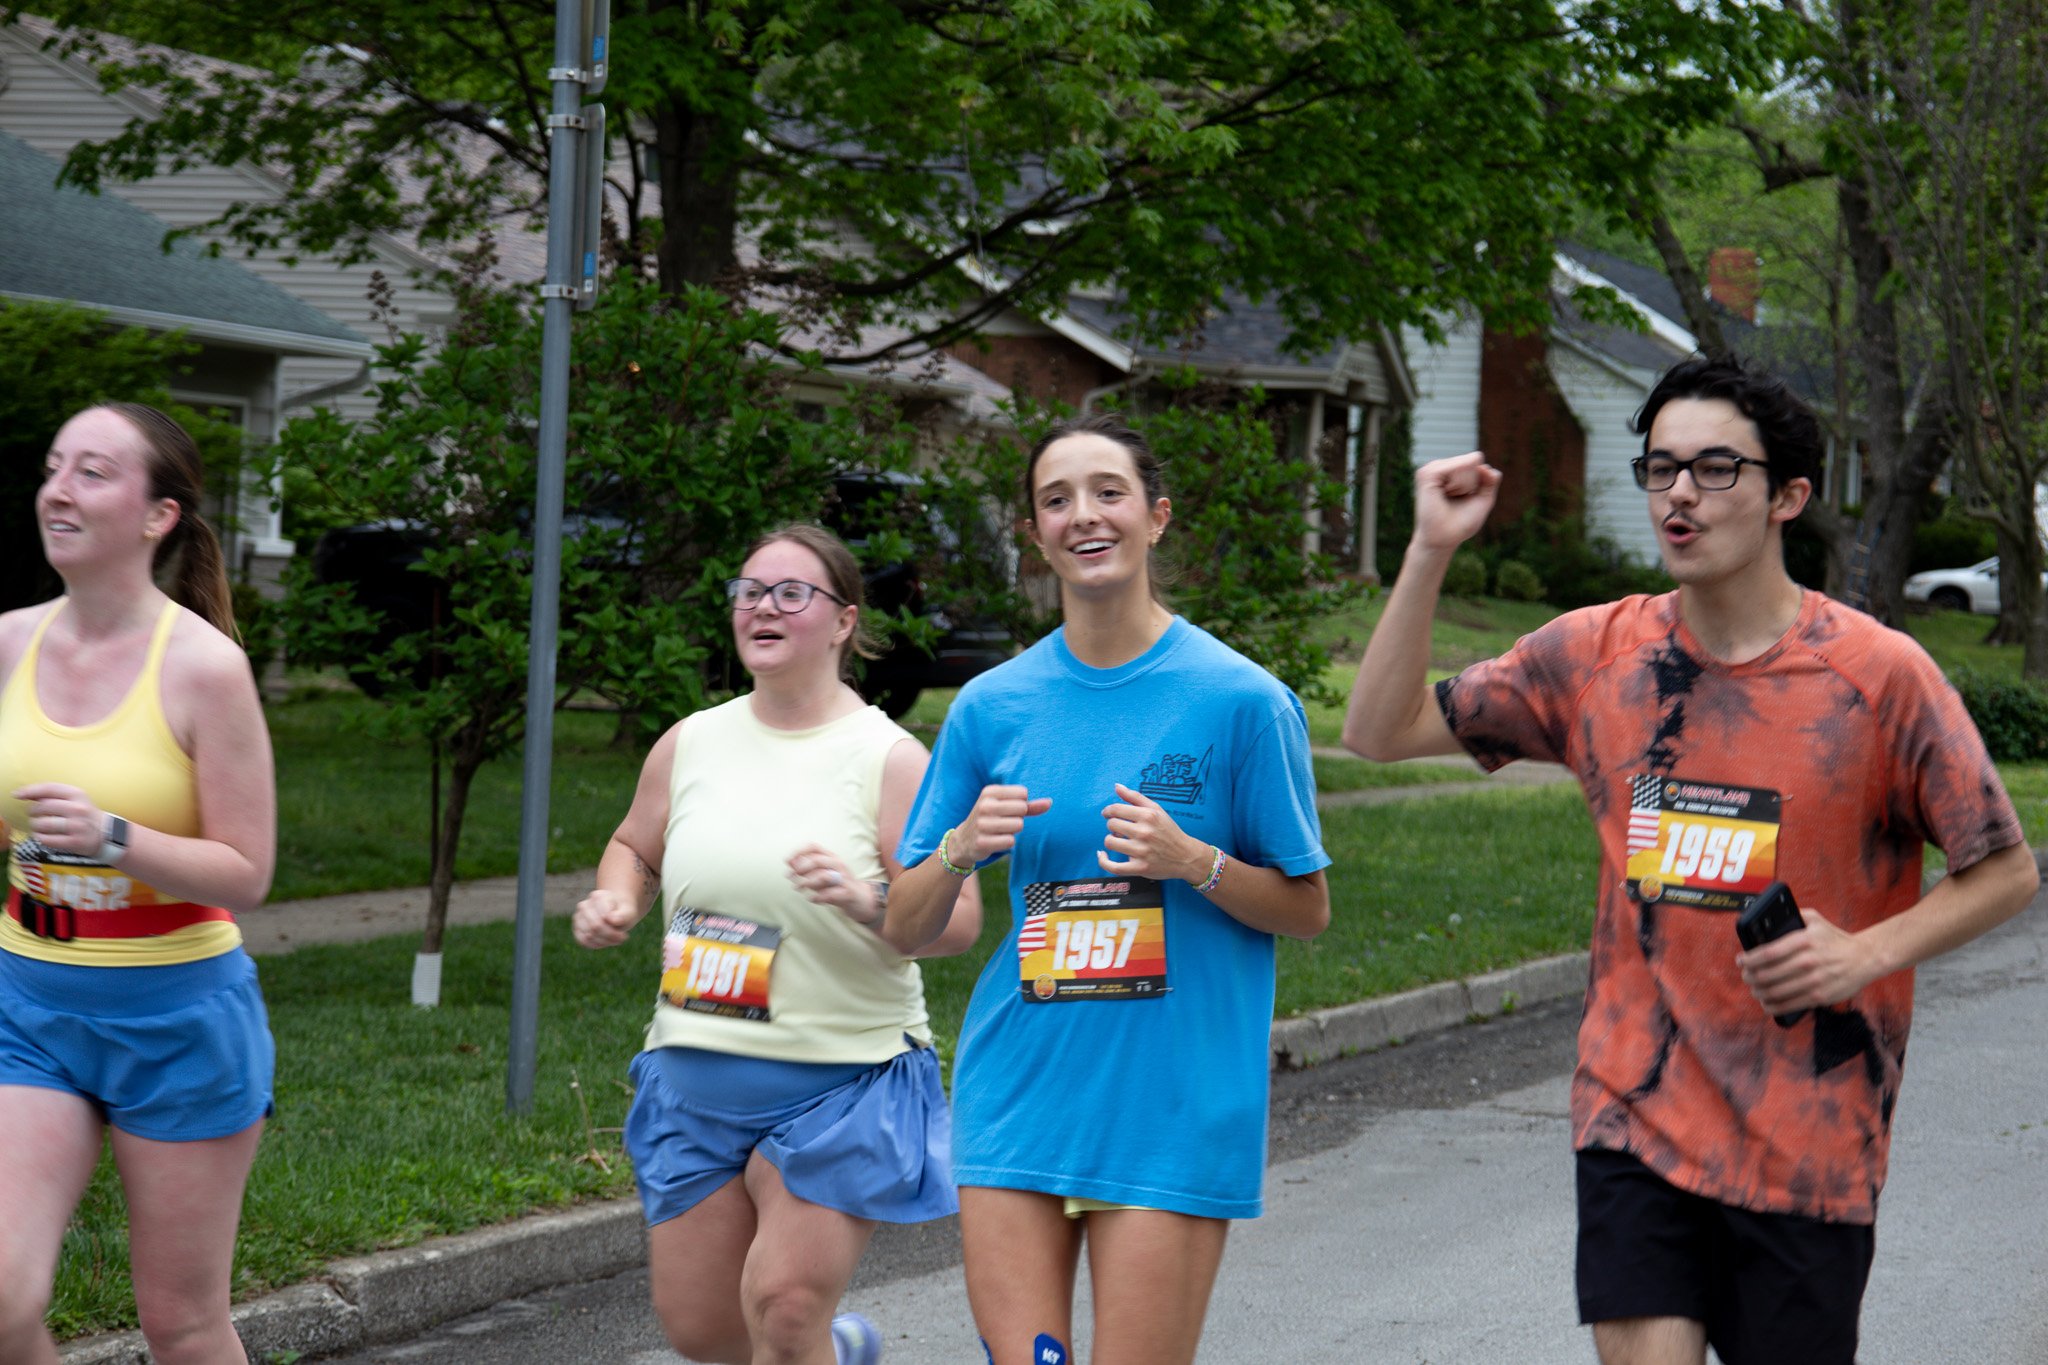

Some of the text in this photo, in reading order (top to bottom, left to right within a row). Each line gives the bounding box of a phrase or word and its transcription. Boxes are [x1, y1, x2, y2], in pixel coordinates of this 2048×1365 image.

[1659, 822, 1756, 883] 1959
[685, 944, 752, 999] 1951
[1051, 918, 1140, 971] 1957
